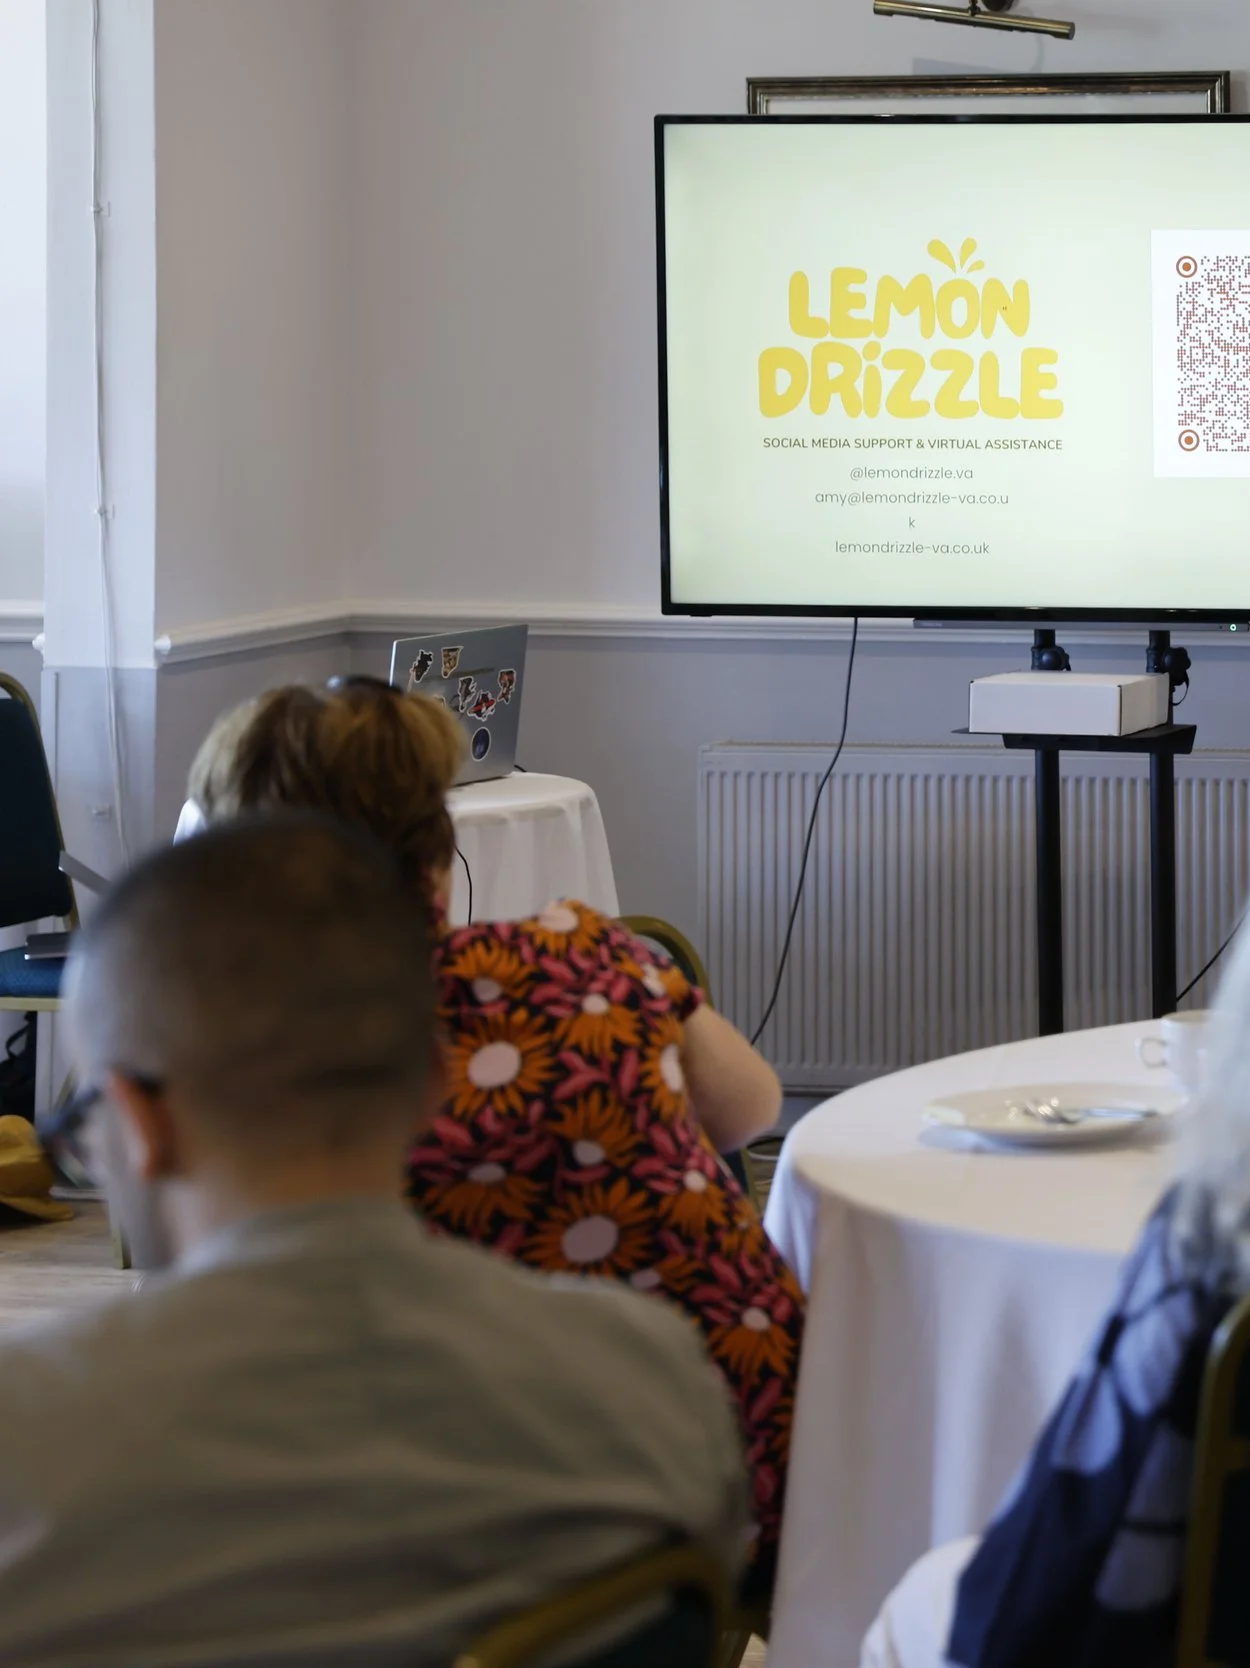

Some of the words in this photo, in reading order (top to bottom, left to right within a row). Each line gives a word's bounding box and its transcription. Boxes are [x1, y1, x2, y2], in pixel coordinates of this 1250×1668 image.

[789, 266, 1030, 339] LEMON
[763, 437, 808, 449] SOCIAL
[811, 437, 851, 449] MEDIA
[854, 437, 913, 449] SUPPORT
[916, 438, 926, 449] &
[928, 438, 982, 450] VIRTUAL
[984, 438, 1063, 450] ASSISTANCE
[849, 466, 974, 480] @lemondrizzle.va
[815, 491, 1009, 506] amy@lemondrizzle-va.co.u
[908, 516, 916, 529] k
[835, 541, 990, 555] lemondrizzle-va.co.uk
